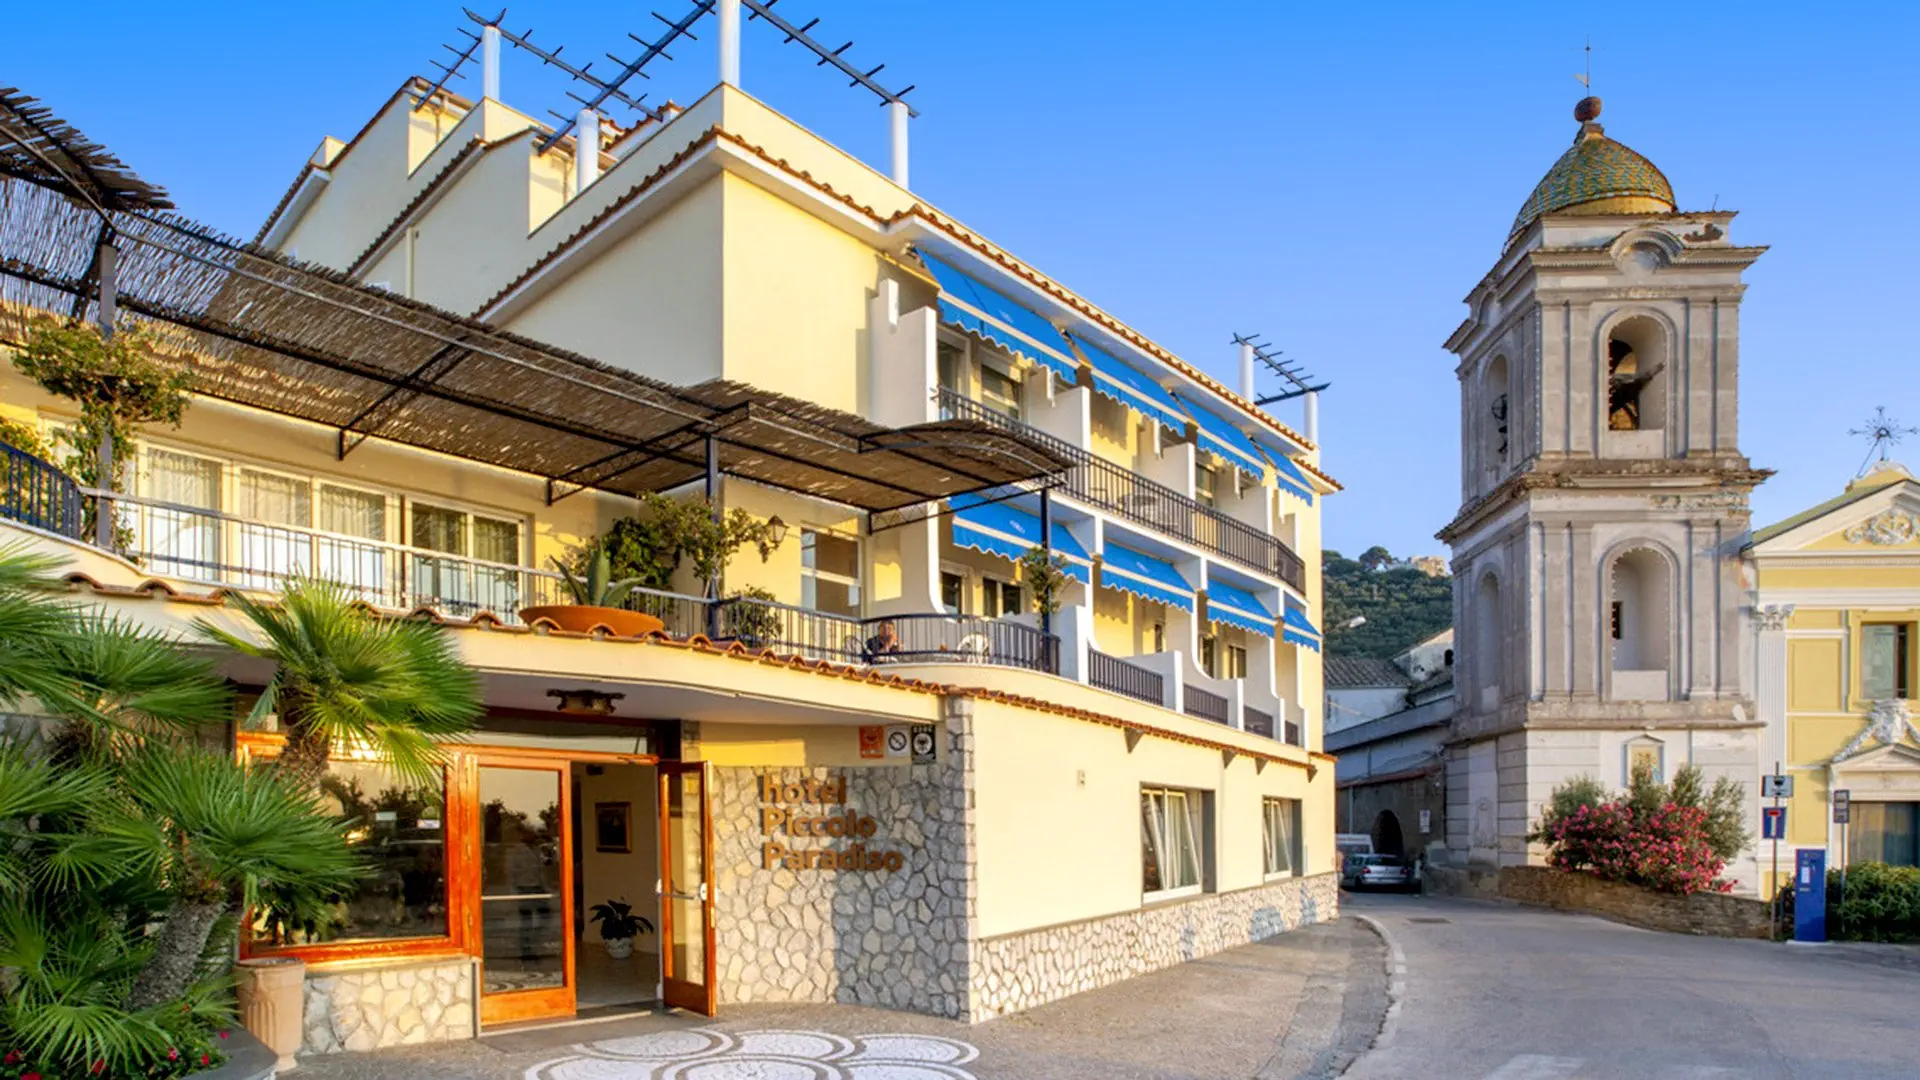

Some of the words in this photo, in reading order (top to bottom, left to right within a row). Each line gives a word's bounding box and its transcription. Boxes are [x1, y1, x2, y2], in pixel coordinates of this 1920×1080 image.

[762, 775, 846, 804] hotel
[763, 807, 877, 838] Piccolo
[763, 842, 904, 872] Paradiso
